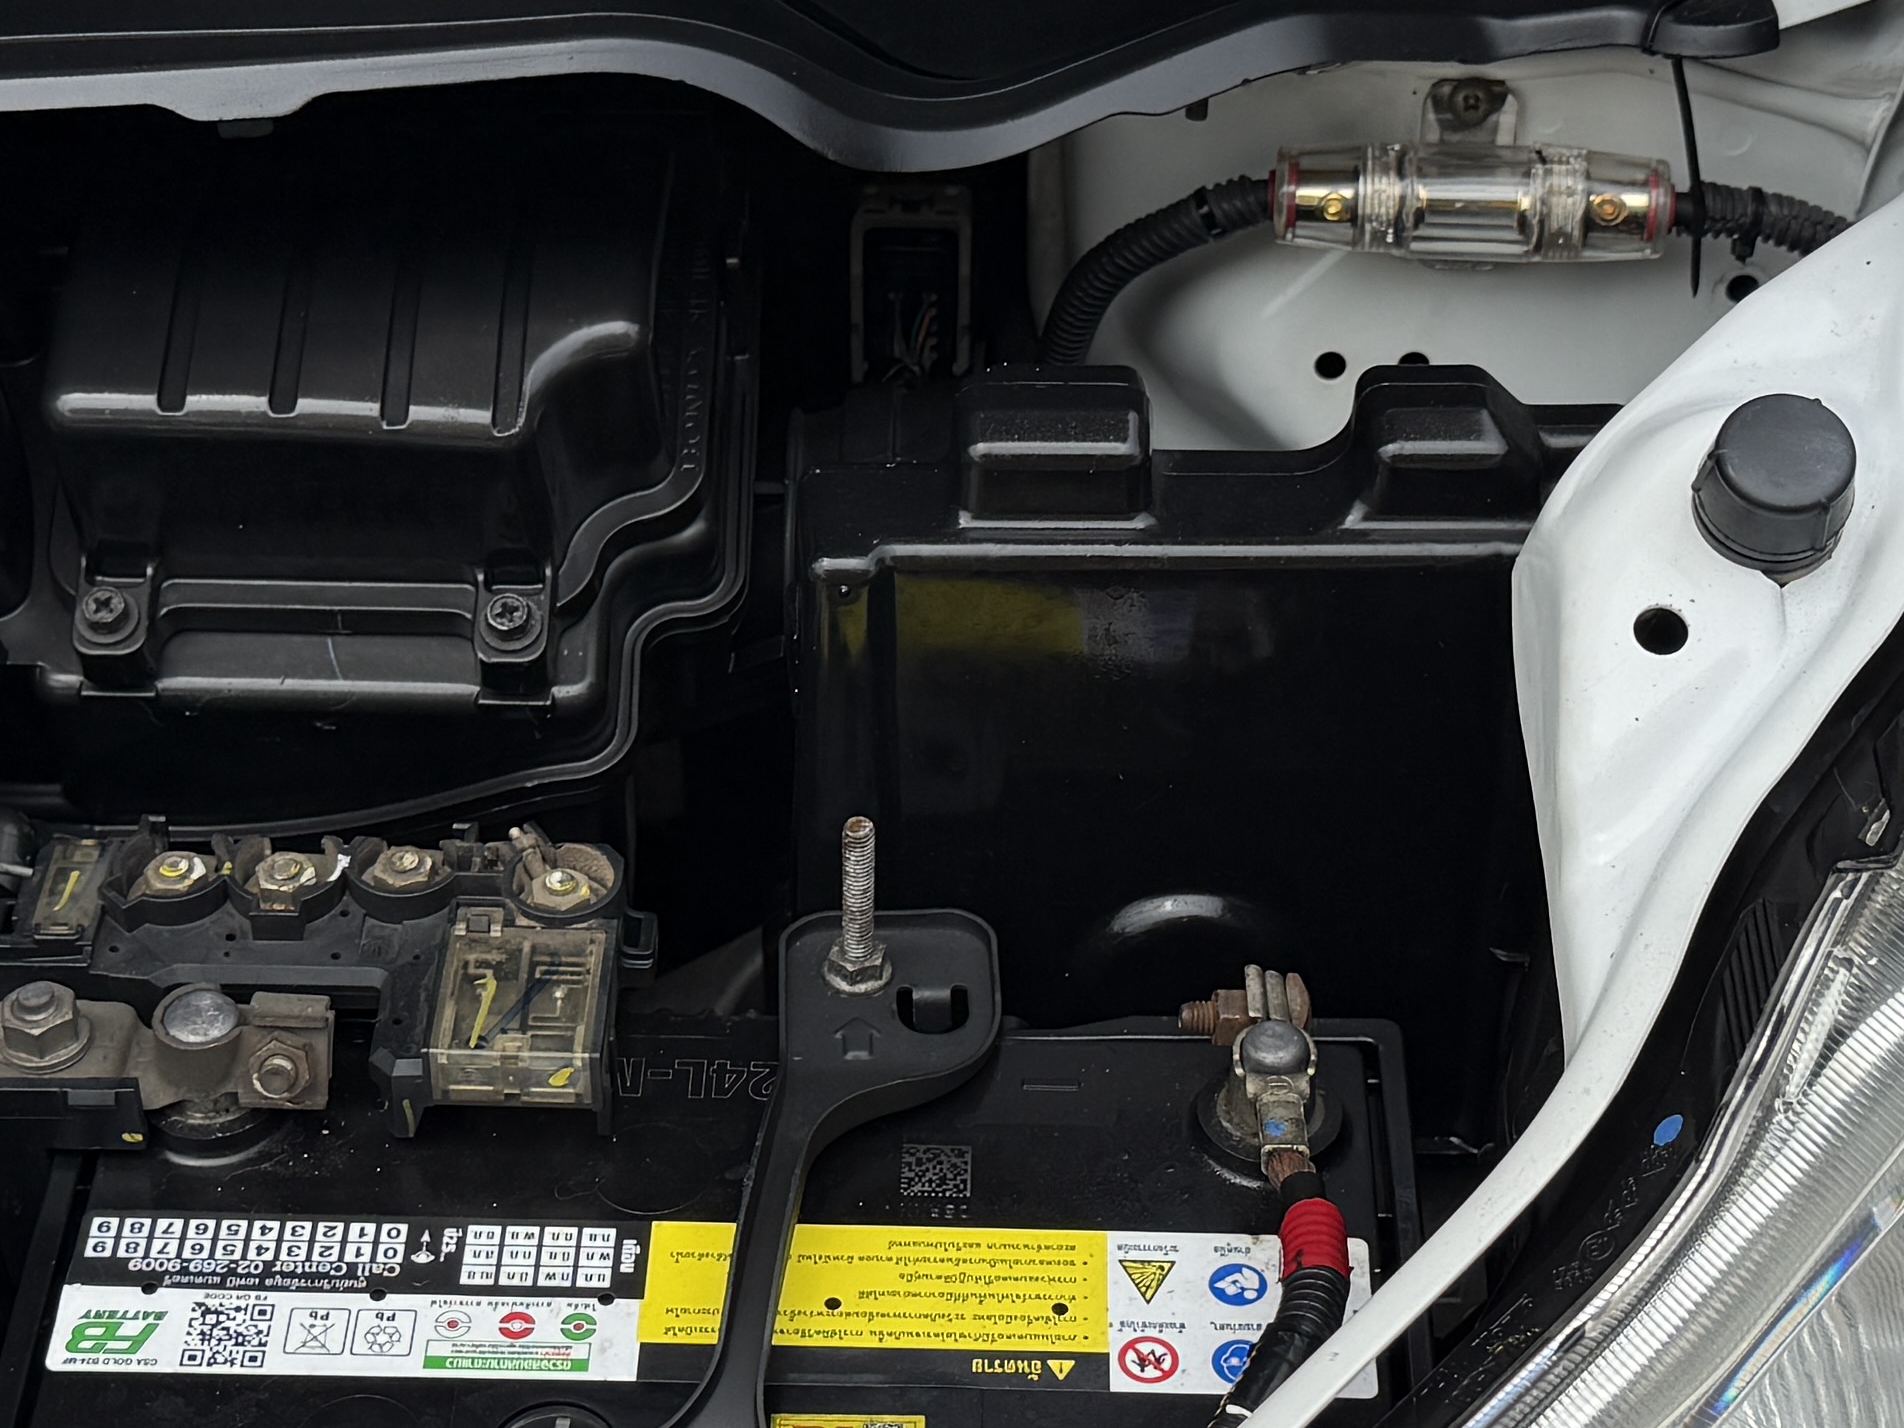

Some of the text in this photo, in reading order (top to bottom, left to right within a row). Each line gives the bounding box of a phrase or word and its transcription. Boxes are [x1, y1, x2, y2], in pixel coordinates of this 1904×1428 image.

[97, 1221, 401, 1240] 0 1 2 3 4 5 6 7 8 9
[92, 1240, 398, 1260] 0 1 2 3 4 5 6 7 8 9
[128, 1259, 400, 1277] Call Center 02-269-9009
[77, 1309, 168, 1321] BATTERY
[309, 1310, 330, 1321] Pb
[375, 1311, 396, 1322] Pb
[64, 1321, 160, 1355] FB
[971, 1358, 1042, 1381] อันตราย
